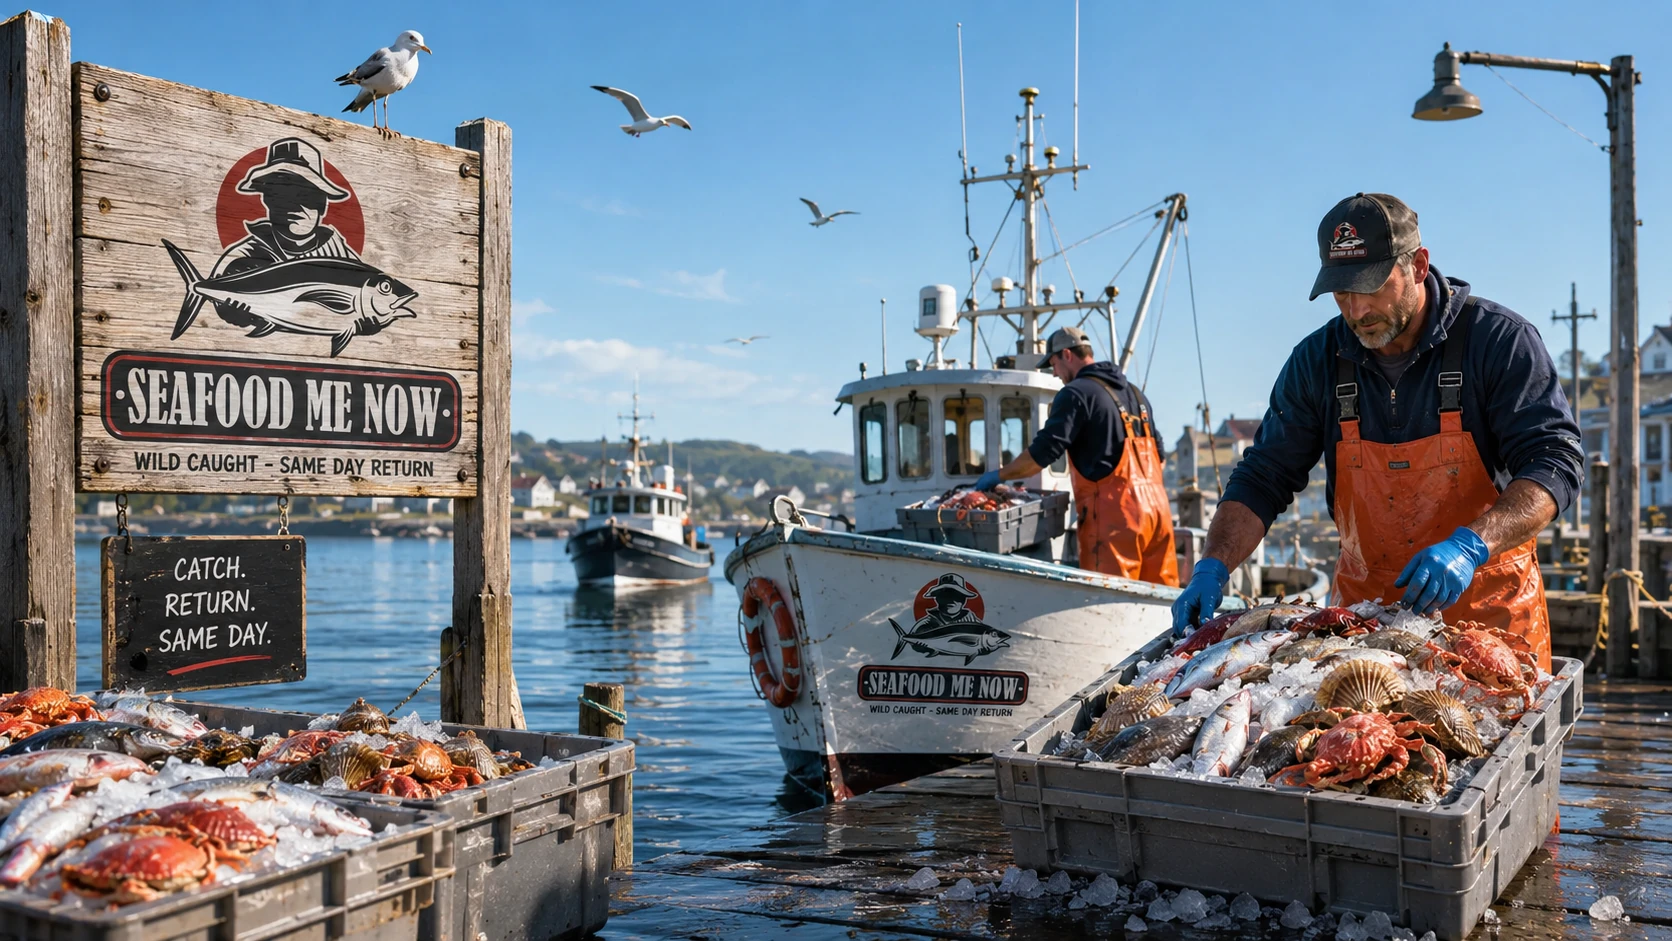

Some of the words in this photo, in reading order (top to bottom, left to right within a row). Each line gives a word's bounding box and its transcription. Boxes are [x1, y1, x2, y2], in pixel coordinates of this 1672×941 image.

[127, 367, 294, 430] SEAFOOD
[305, 378, 353, 433] ME
[362, 382, 442, 437] NOW
[134, 451, 180, 472] WILD
[187, 453, 259, 473] CAUGHT
[279, 456, 326, 475] SAME
[333, 458, 365, 476] DAY
[371, 459, 434, 477] RETURN
[174, 556, 246, 582] CATCH.
[165, 589, 256, 617] RETURN.
[158, 625, 219, 653] SAME
[228, 621, 271, 648] DAY.
[868, 671, 946, 697] SEAFOOD
[950, 674, 975, 698] ME
[978, 676, 1019, 700] NOW
[869, 705, 890, 714] WILD
[892, 705, 926, 715] CAUGHT
[935, 707, 959, 716] SAME
[962, 707, 979, 717] DAY
[980, 707, 1013, 717] RETURN
